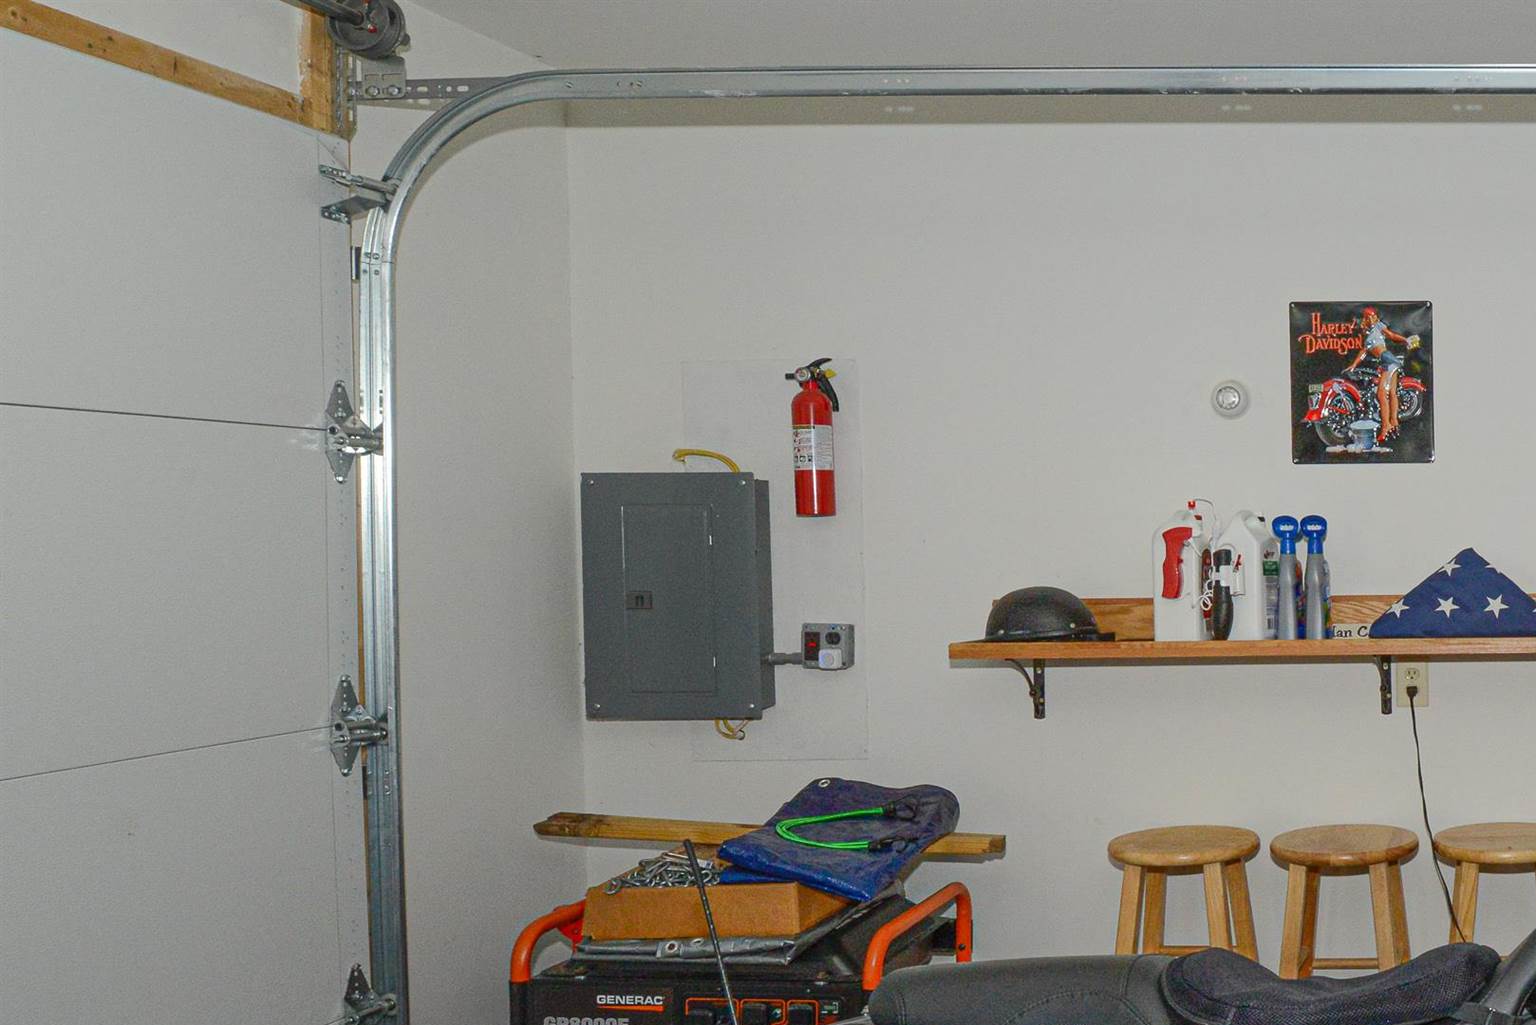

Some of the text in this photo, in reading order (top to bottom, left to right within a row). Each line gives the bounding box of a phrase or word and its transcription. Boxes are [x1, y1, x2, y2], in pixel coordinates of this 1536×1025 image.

[1311, 312, 1357, 337] HARLEY
[1298, 333, 1364, 355] DAVIDSON
[596, 994, 664, 1006] GENERAC
